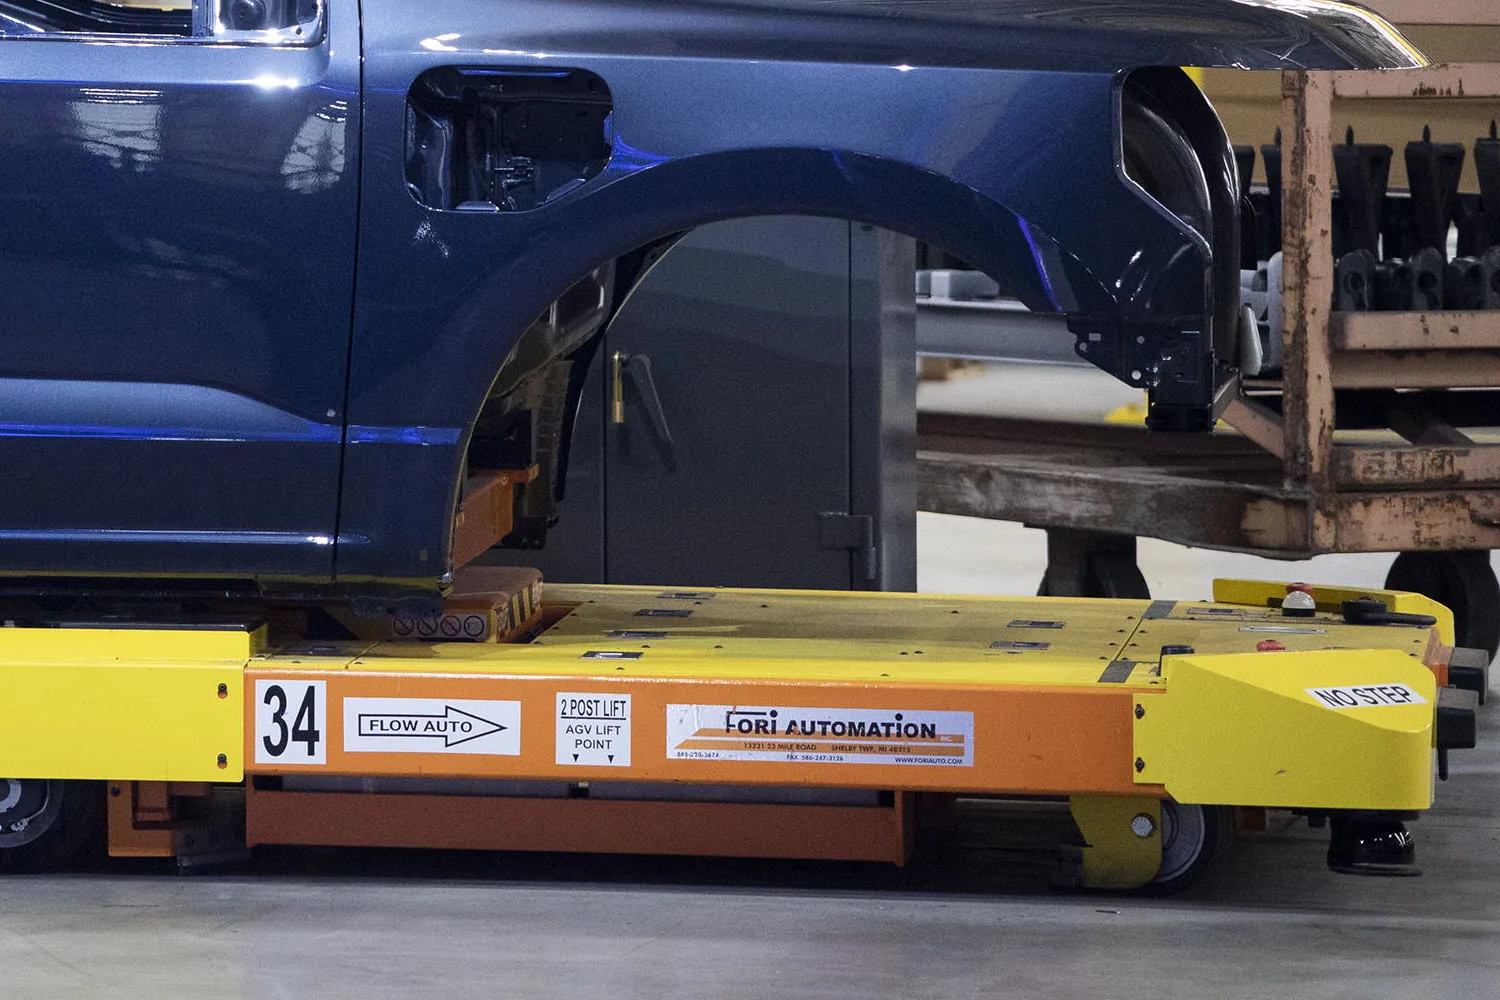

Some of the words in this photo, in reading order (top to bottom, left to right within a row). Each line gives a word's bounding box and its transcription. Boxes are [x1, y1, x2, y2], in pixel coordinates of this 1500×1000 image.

[1313, 689, 1359, 707] NO
[1352, 686, 1412, 705] STEP
[561, 698, 567, 716] 2
[570, 699, 601, 716] POST
[603, 700, 627, 717] LIFT
[262, 684, 320, 757] 34
[369, 719, 418, 732] FLOW
[423, 720, 473, 733] AUTO
[565, 724, 592, 735] AGV
[595, 725, 622, 736] LIFT
[575, 739, 613, 750] POINT
[777, 743, 794, 751] MILE
[831, 744, 857, 752] SHELBY
[786, 753, 799, 761] FAX
